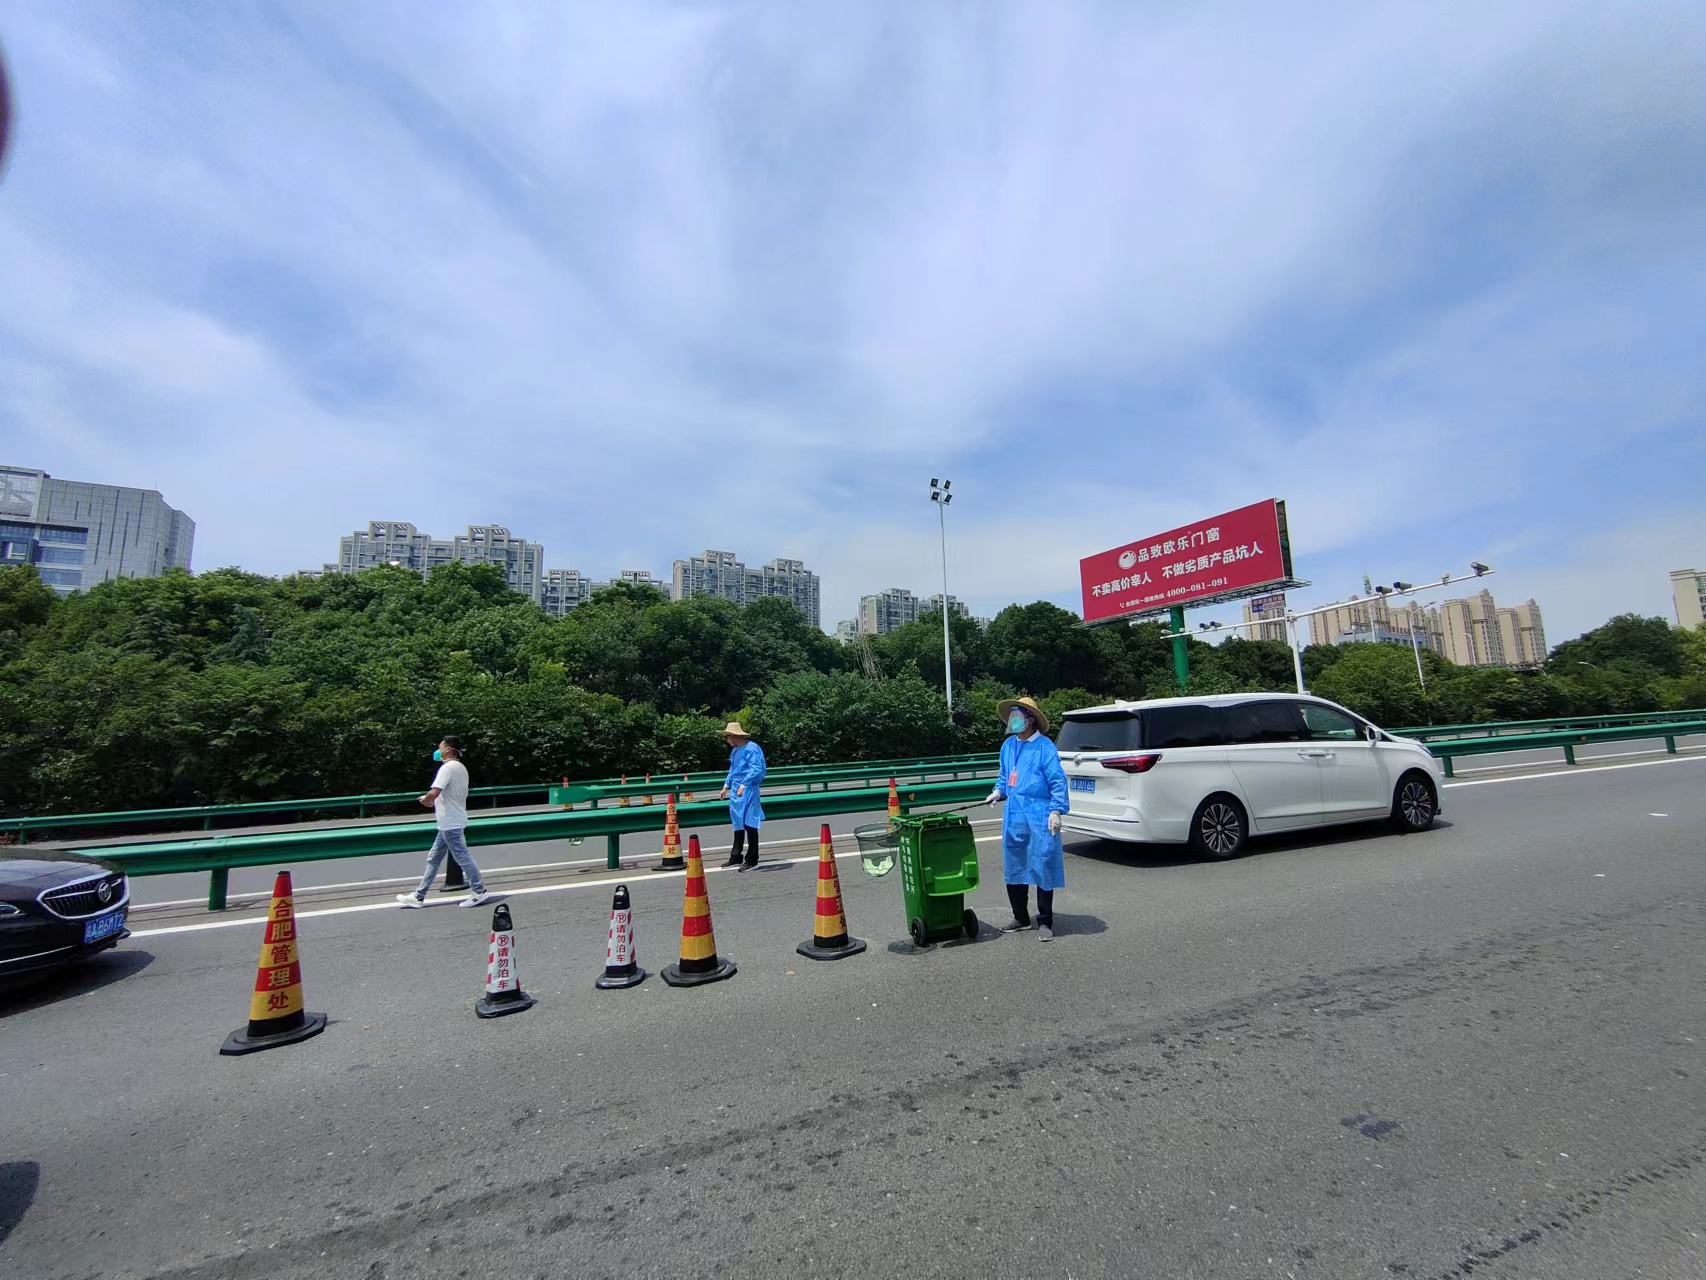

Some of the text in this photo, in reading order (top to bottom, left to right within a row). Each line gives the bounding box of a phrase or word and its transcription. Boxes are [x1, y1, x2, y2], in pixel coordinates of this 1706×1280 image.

[1138, 527, 1220, 563] 品致欧乐门窗
[1091, 541, 1264, 597] 不卖高价宰人 不做劣质产品坑人
[1165, 577, 1228, 598] 4000-081-091
[667, 805, 677, 854] 合肥管理处
[267, 899, 293, 1012] 合肥管理处
[616, 924, 627, 963] 请勿泊车
[497, 947, 510, 990] 请勿泊车
